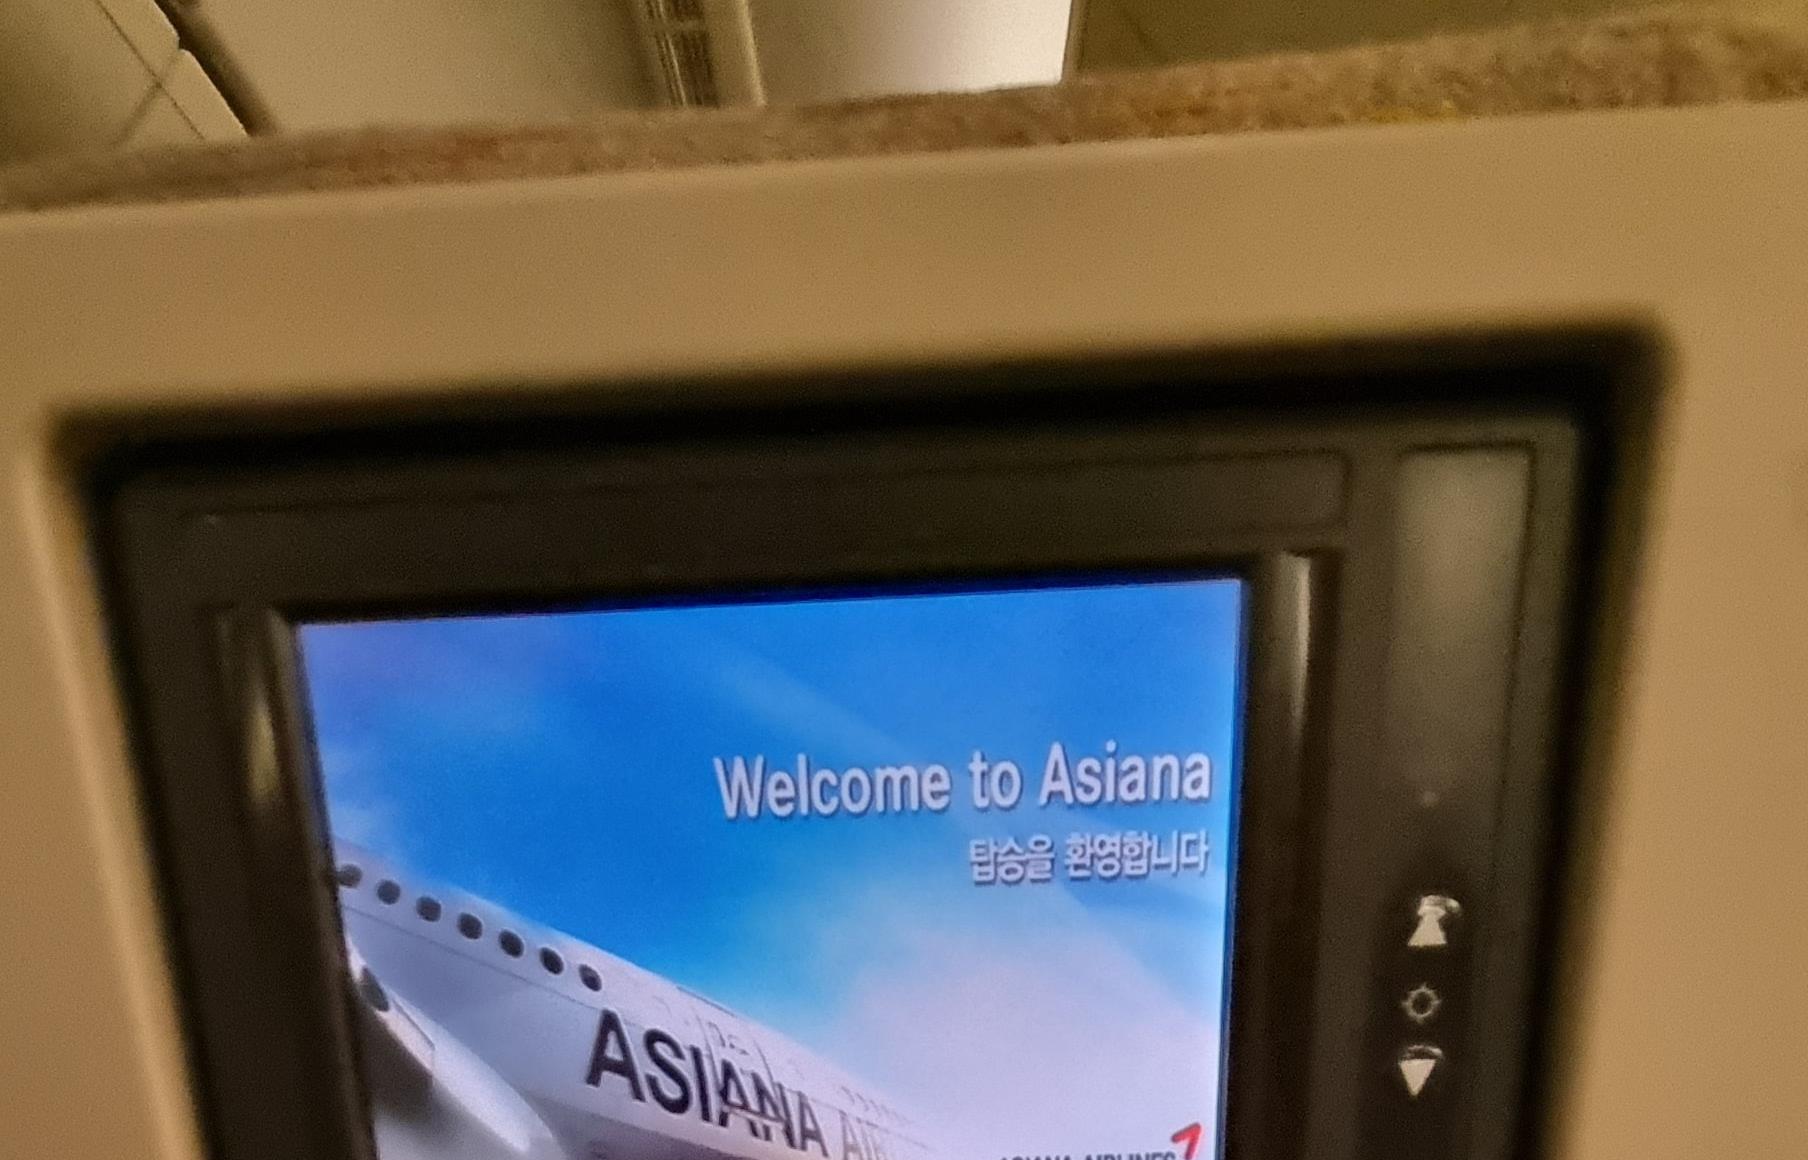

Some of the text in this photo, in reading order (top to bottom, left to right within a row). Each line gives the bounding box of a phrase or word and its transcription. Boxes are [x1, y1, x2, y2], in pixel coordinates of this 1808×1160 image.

[712, 739, 1212, 820] Welcome to Asiana
[968, 828, 1209, 885] 탑승을 환영합니다
[585, 1007, 829, 1158] ASIANA
